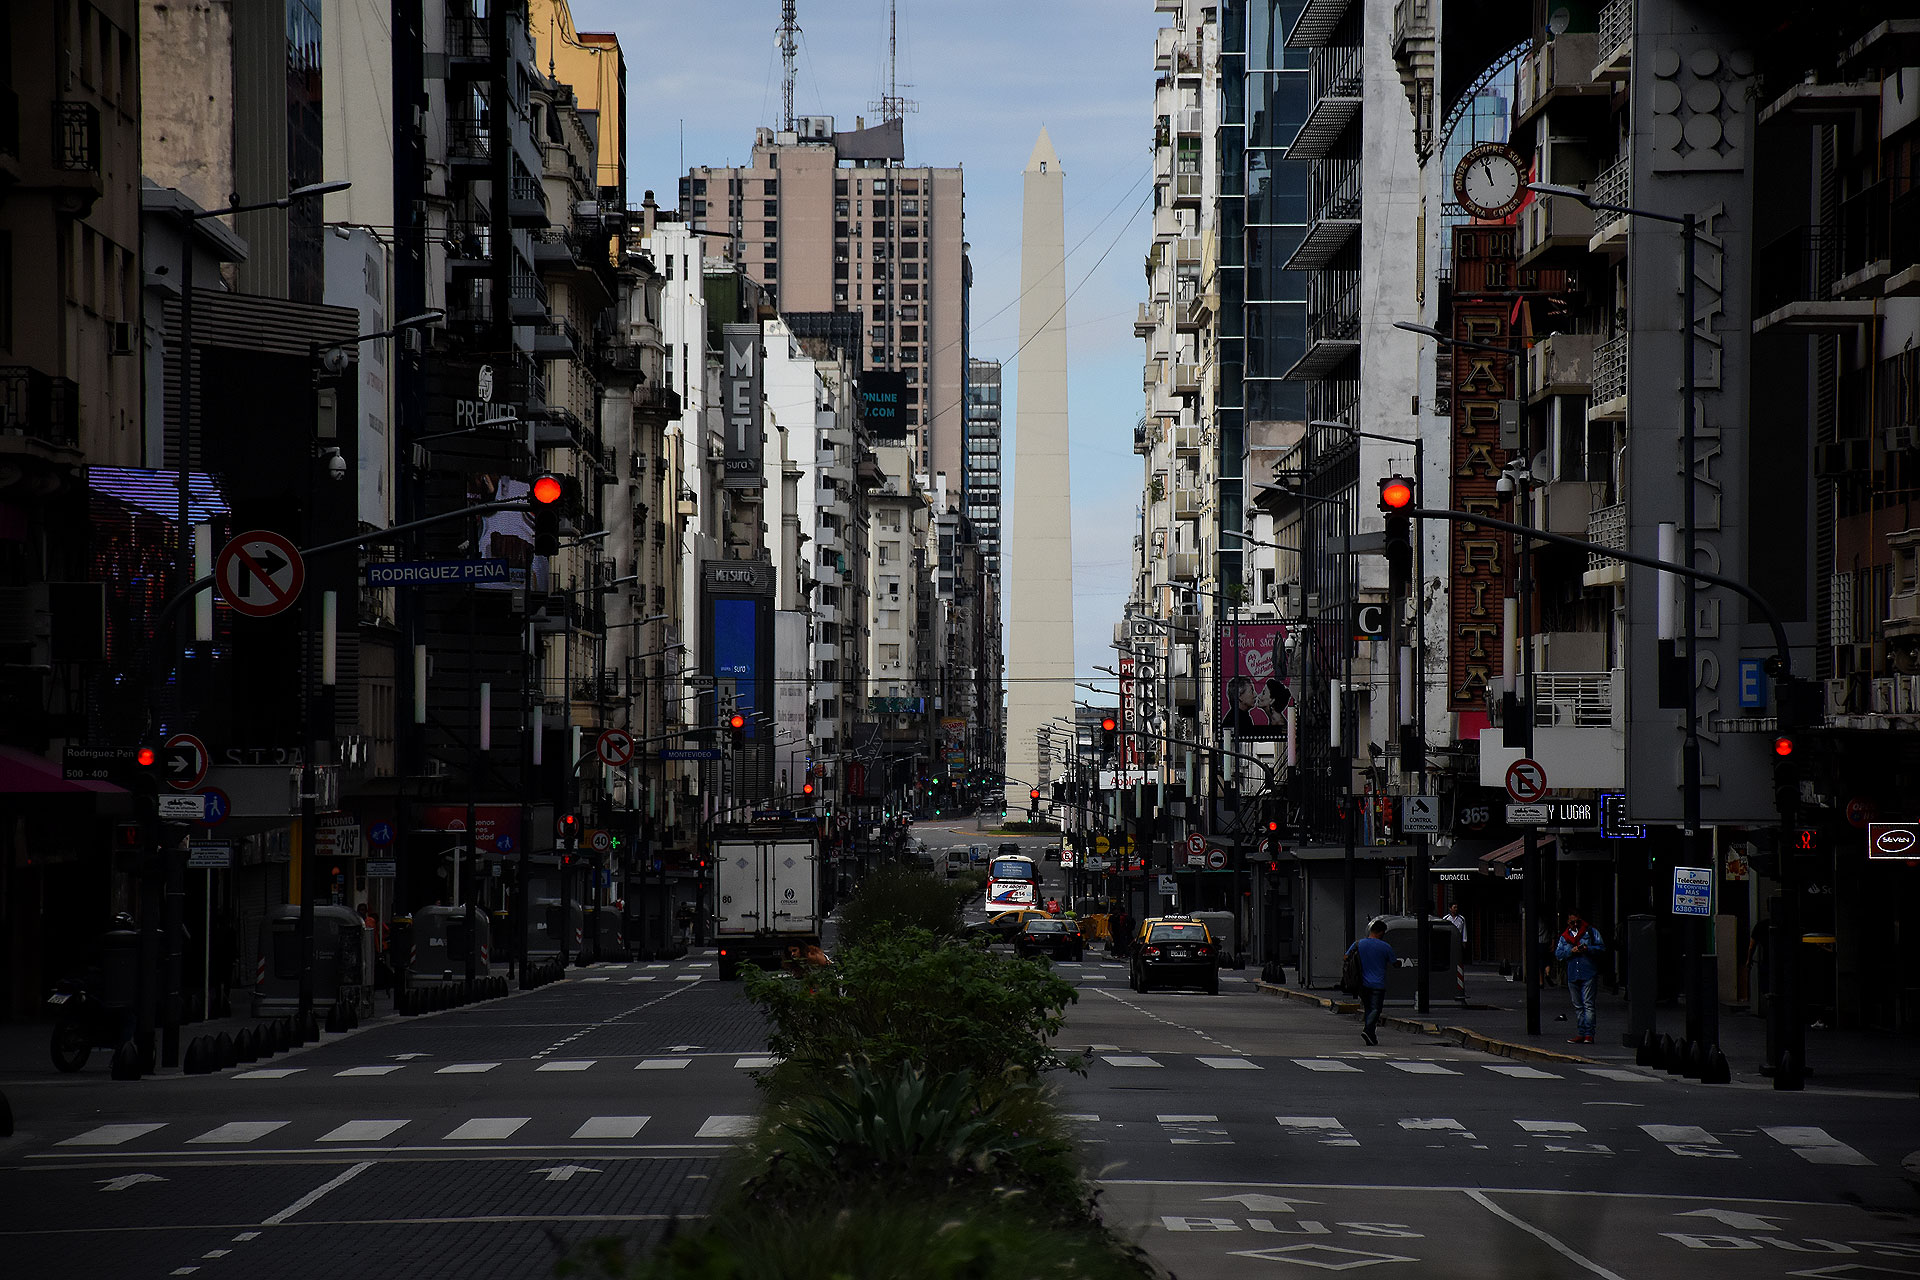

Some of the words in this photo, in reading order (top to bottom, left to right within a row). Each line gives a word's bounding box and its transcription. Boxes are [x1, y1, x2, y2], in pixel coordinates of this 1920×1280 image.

[1456, 162, 1468, 192] DONDE
[1467, 144, 1505, 161] SIEMPRE
[1508, 151, 1523, 166] SON
[1519, 168, 1528, 186] LAS
[1466, 201, 1486, 217] PARA
[1493, 198, 1521, 218] COMER
[1460, 233, 1480, 258] EL
[1489, 232, 1511, 257] PA
[1677, 201, 1724, 440] PLAZA
[729, 341, 754, 452] MET
[1459, 316, 1504, 477] PAPA
[456, 400, 517, 431] PREMIER
[726, 460, 748, 470] sura
[371, 566, 460, 582] RODRIGUEZ
[464, 561, 506, 578] PEÑA
[1454, 497, 1502, 700] FRITA
[1134, 623, 1168, 636] CIN
[1359, 606, 1382, 633] C
[1742, 663, 1757, 702] E
[67, 748, 115, 758] Rodriguez
[66, 769, 84, 777] 500
[92, 769, 109, 778] 400
[320, 816, 355, 827] PROMO
[1461, 805, 1490, 825] 365
[1560, 804, 1591, 820] LUGAR
[594, 835, 607, 846] 40
[1677, 877, 1709, 885] Telecentro
[1675, 905, 1708, 914] 6380-1111
[1160, 1216, 1425, 1238] BUS
[1658, 1232, 1920, 1258] BUS
